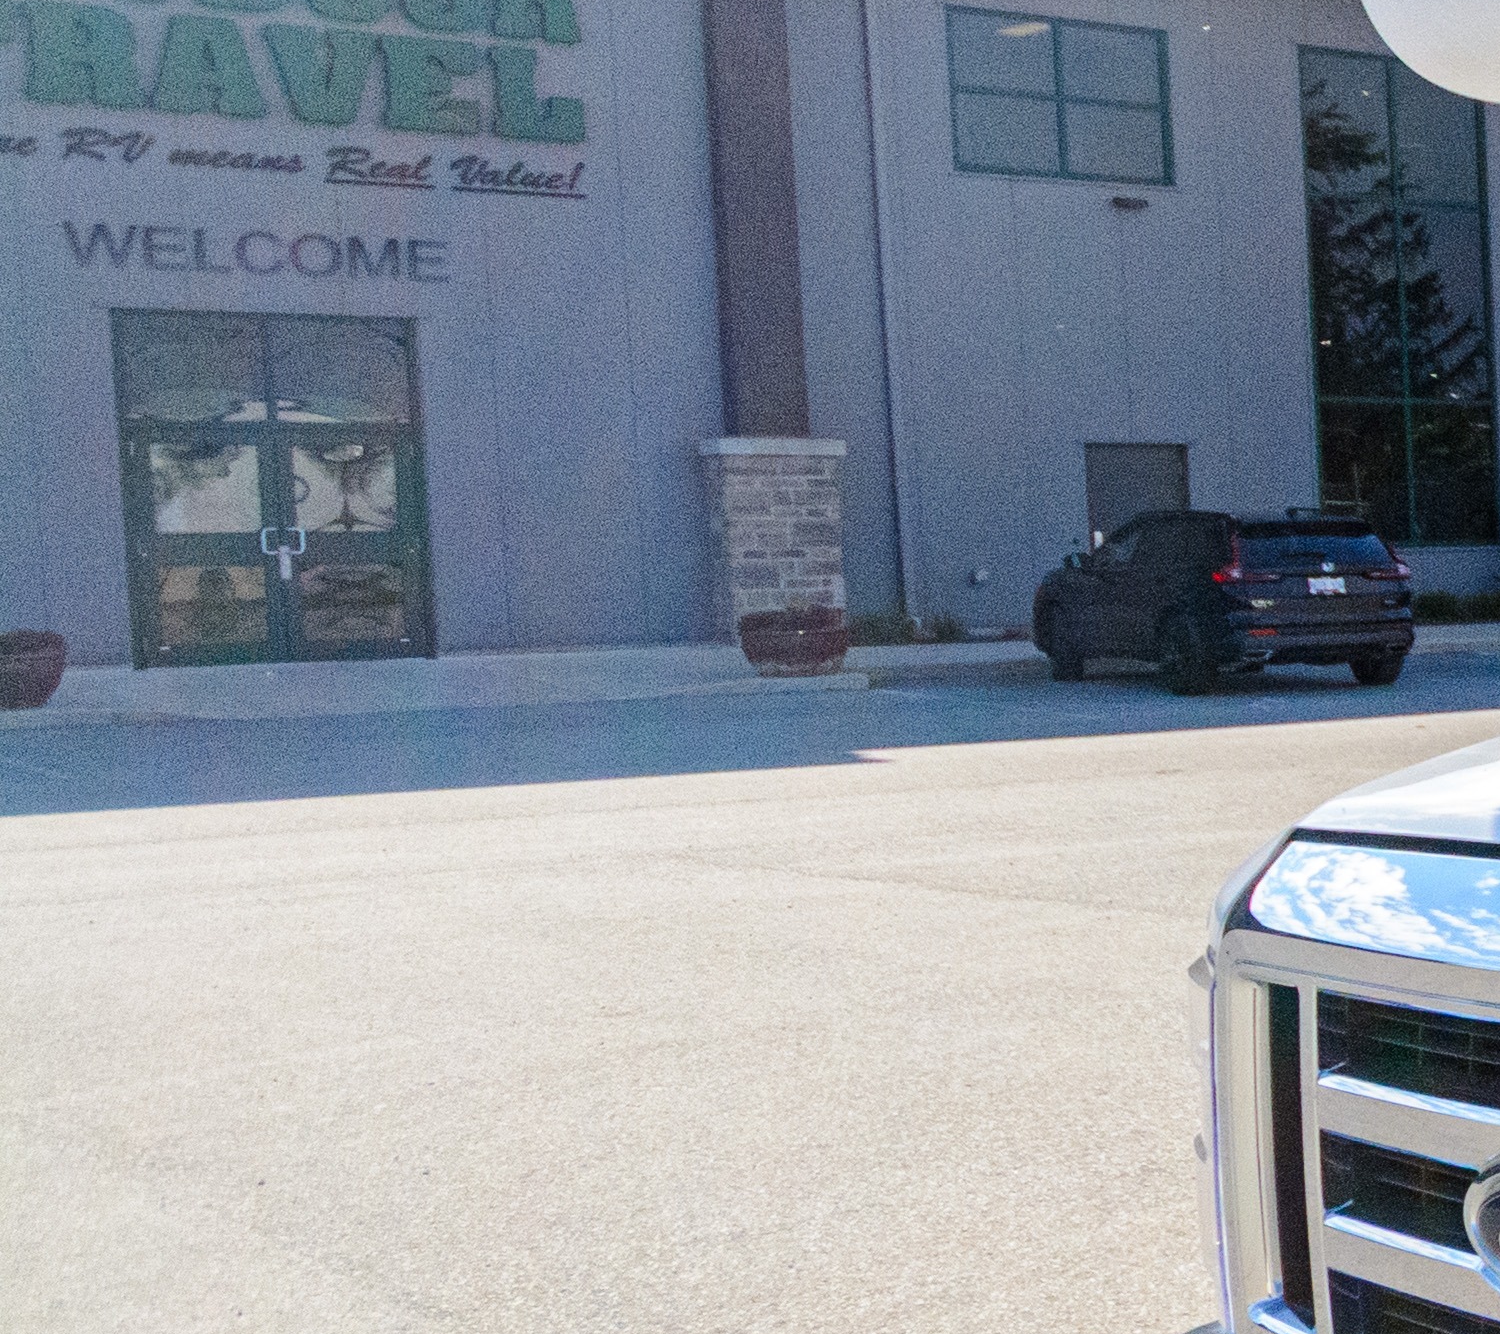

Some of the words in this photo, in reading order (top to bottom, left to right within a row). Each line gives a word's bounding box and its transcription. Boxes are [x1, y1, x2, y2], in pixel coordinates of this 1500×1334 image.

[60, 127, 155, 163] RV
[168, 149, 305, 173] means
[325, 146, 433, 181] Real
[449, 155, 586, 191] Value!
[61, 219, 451, 284] WELCOME
